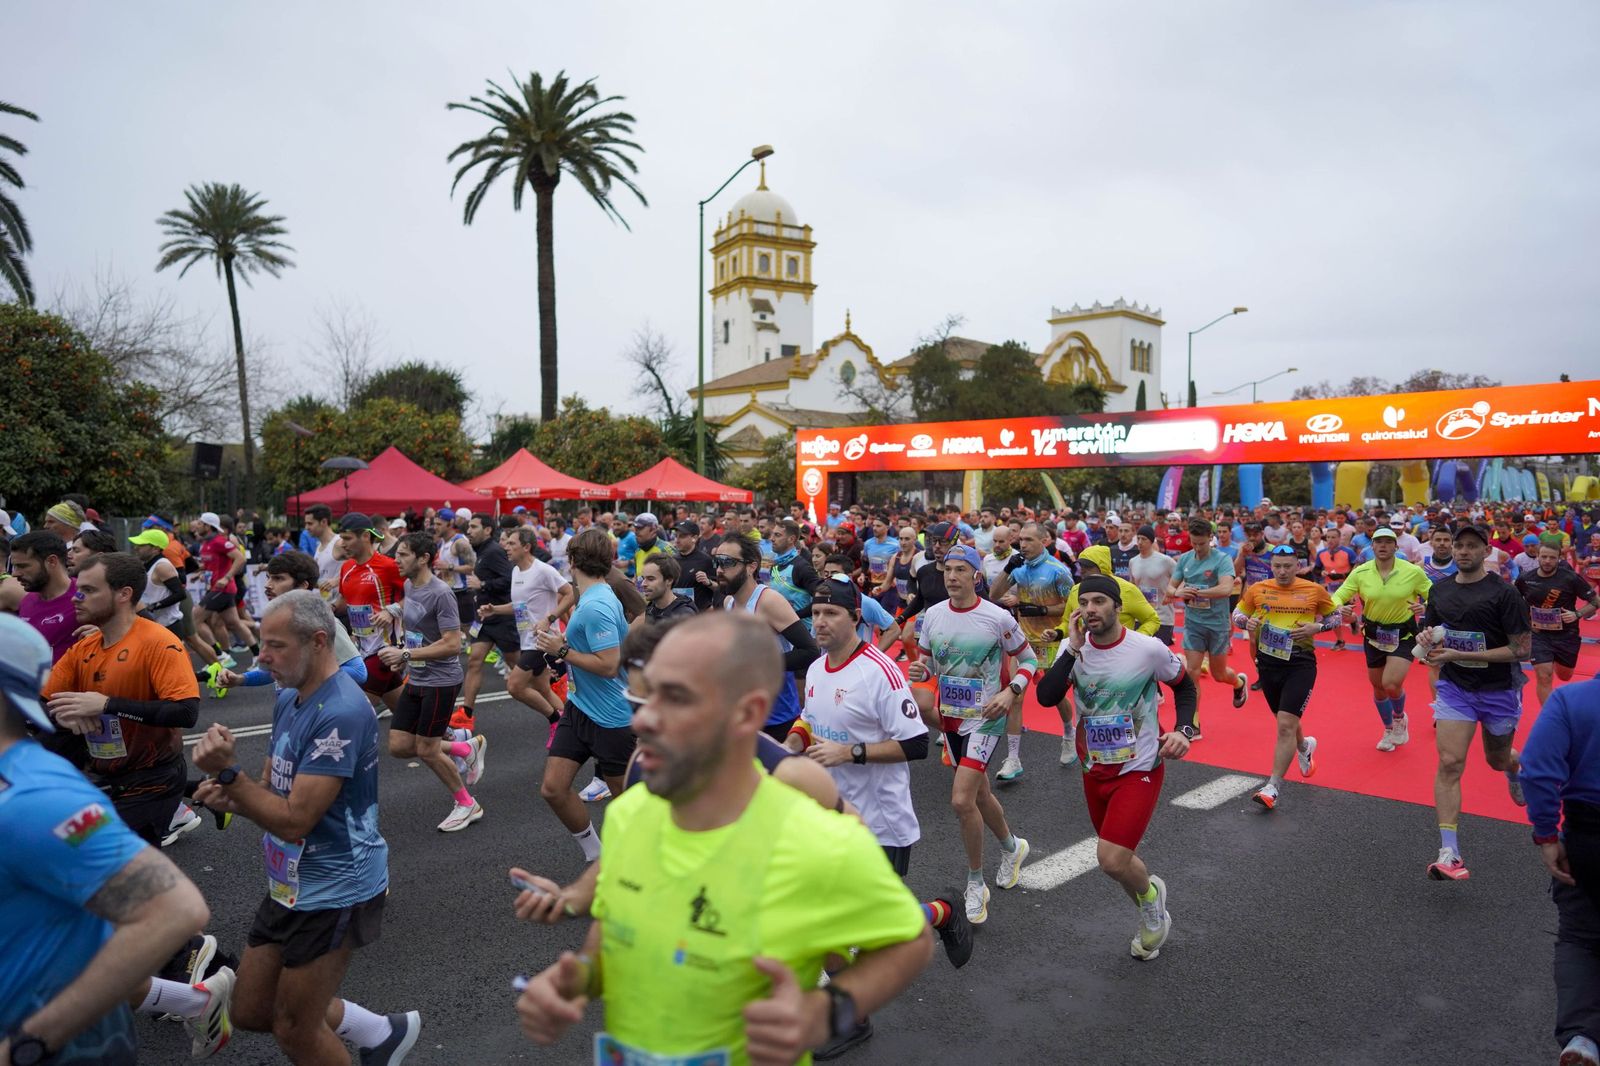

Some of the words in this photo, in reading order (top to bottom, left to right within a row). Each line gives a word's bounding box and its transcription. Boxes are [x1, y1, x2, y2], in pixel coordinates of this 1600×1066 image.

[1489, 410, 1585, 428] Sprinter
[1053, 422, 1126, 441] maratón
[1222, 421, 1288, 443] HOKA
[1299, 433, 1350, 444] HYUNDAI
[1361, 428, 1429, 442] quirónsalud
[1263, 630, 1285, 644] 3194
[1446, 637, 1475, 652] 2543
[945, 686, 972, 701] 2580
[117, 711, 144, 722] KIPRUN
[1090, 727, 1121, 744] 2600
[185, 949, 198, 974] HOKA
